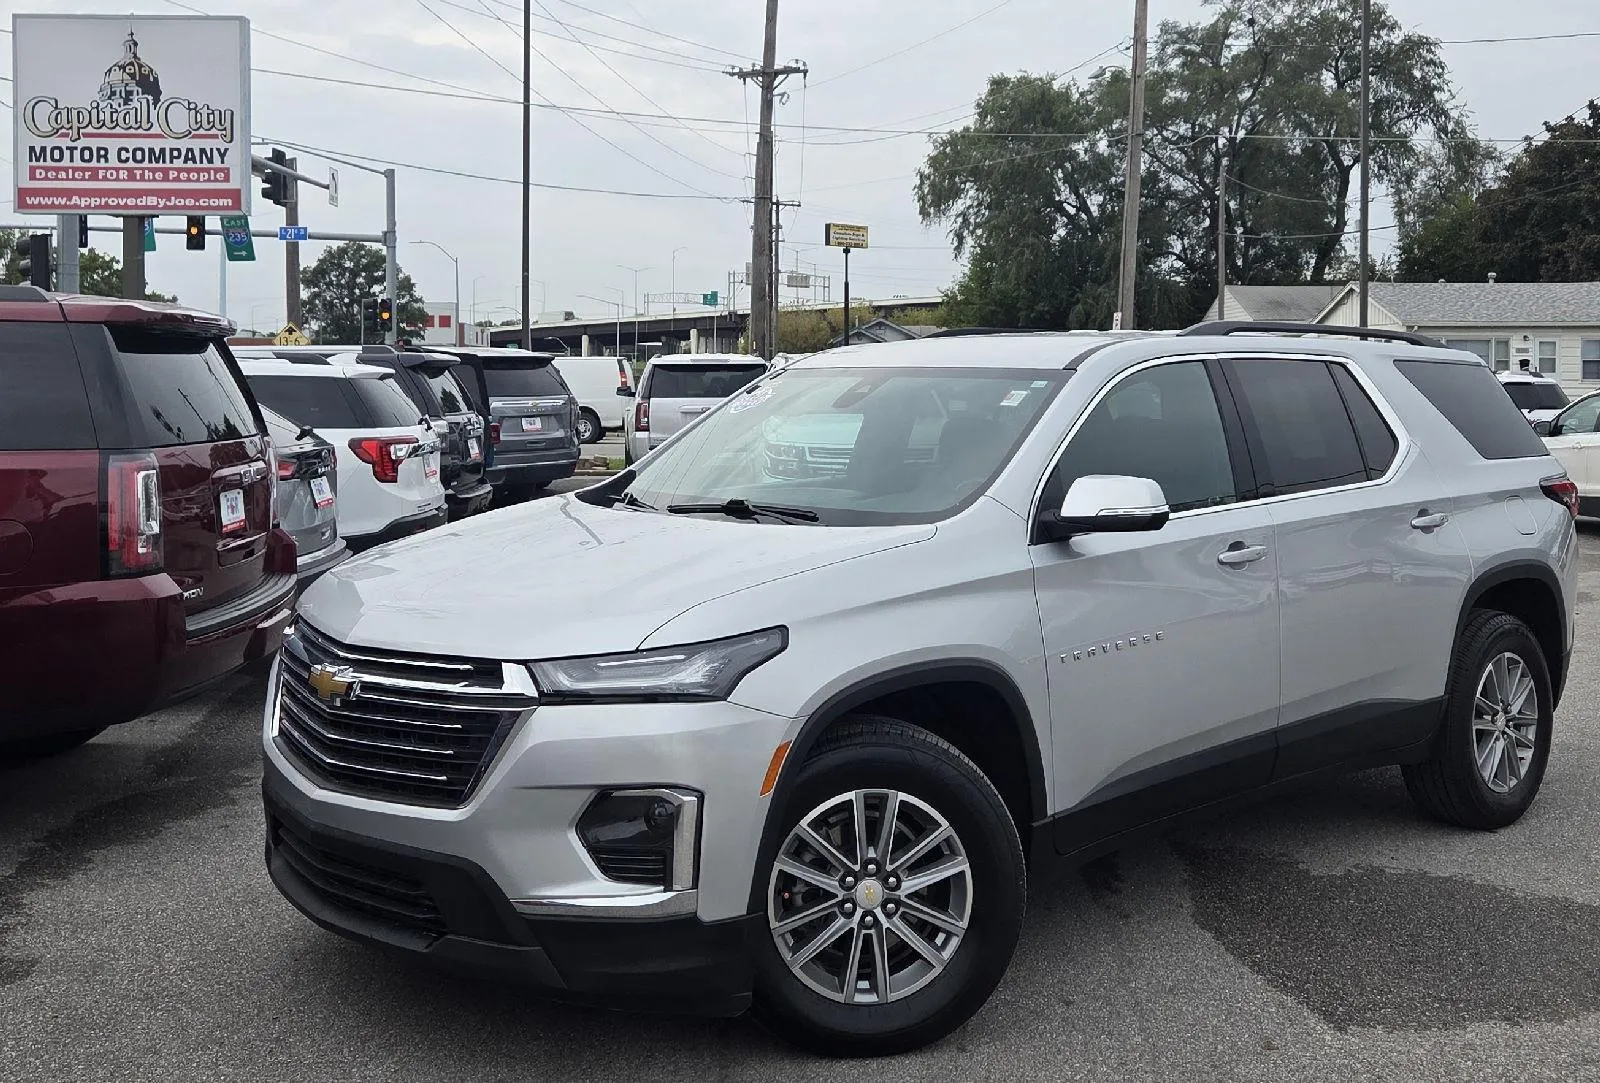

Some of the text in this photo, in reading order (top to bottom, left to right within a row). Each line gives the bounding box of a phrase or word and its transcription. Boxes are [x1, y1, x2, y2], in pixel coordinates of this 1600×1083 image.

[23, 96, 234, 143] Capital City
[28, 146, 229, 165] MOTOR COMPANY
[35, 168, 225, 182] Dealer FOR The People
[25, 195, 233, 208] www.ApprovedByJoe.com
[228, 232, 247, 242] 235
[1059, 631, 1164, 664] TRAVERSE
